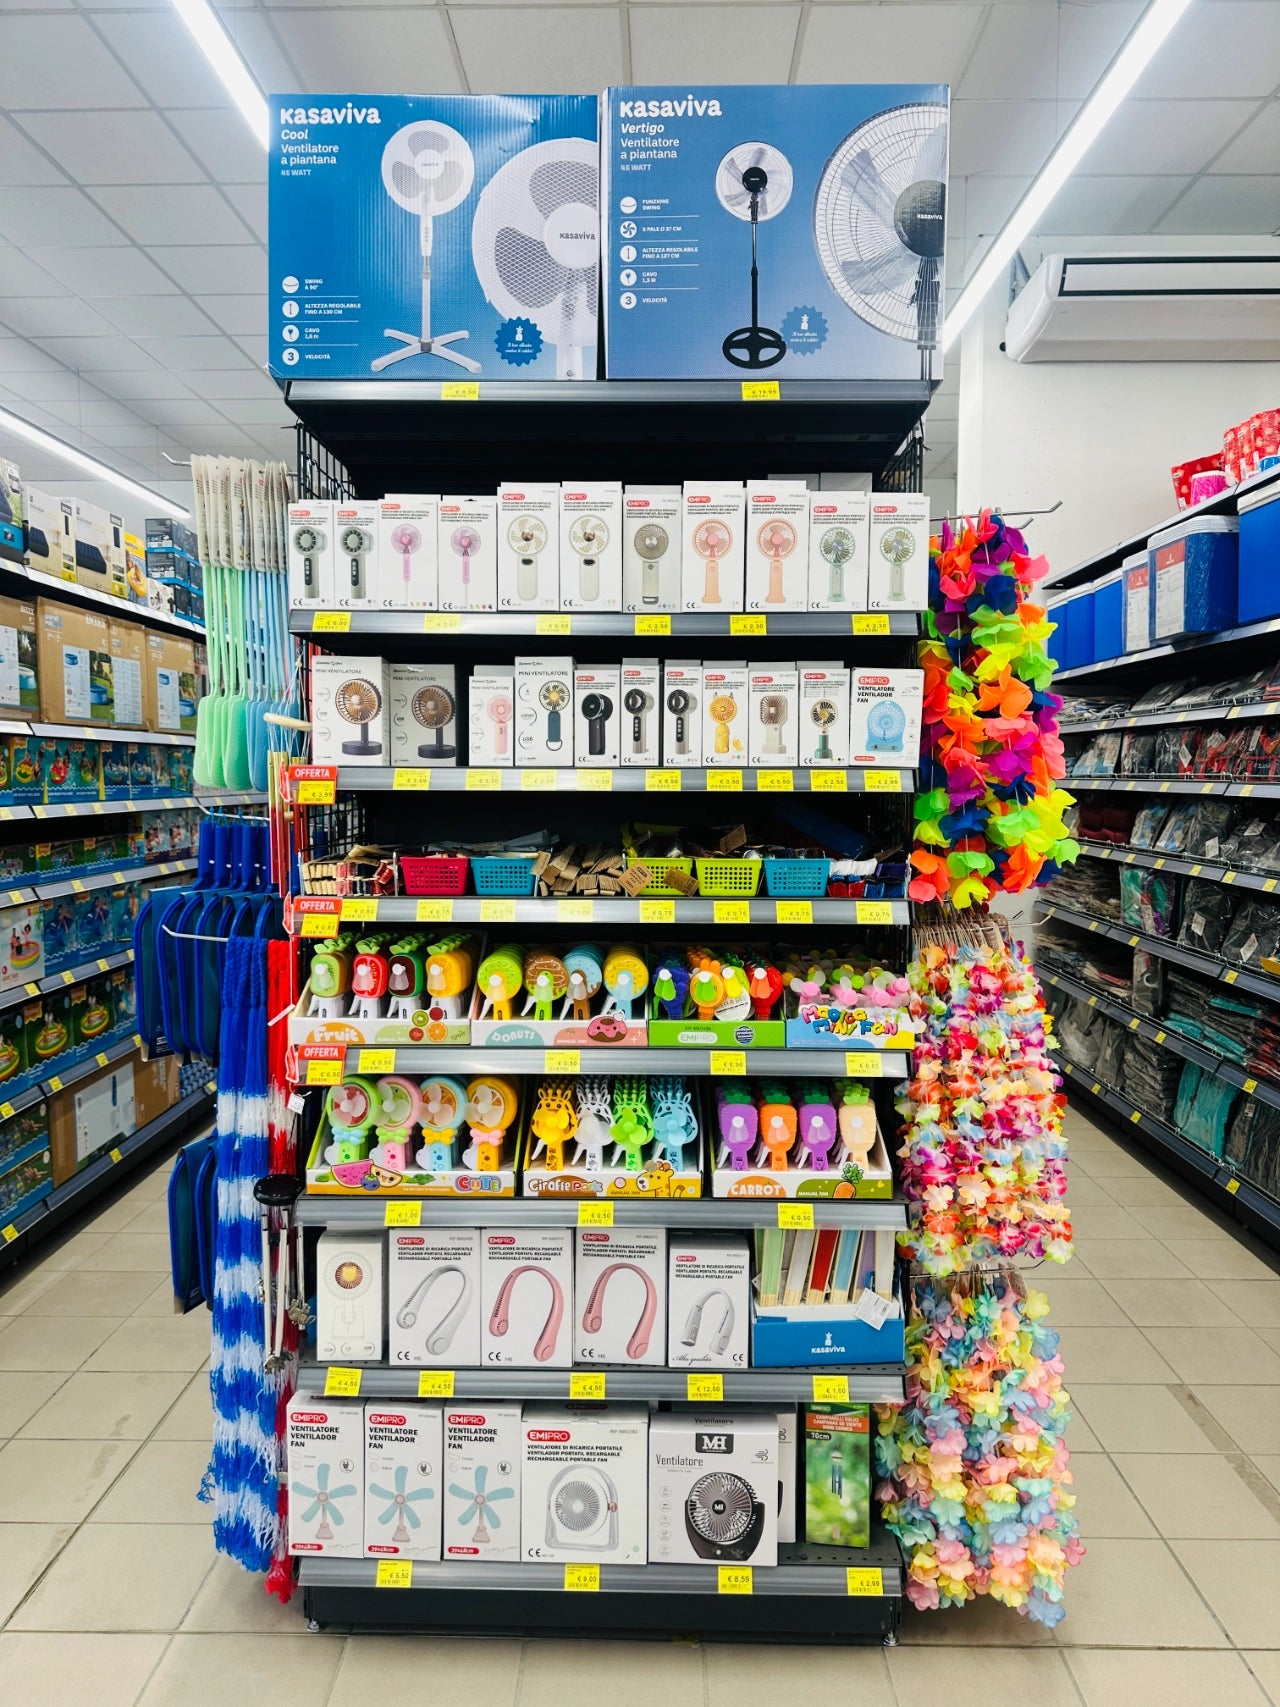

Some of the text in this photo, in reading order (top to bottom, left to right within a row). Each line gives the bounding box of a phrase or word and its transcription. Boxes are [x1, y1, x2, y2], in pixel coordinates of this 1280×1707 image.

[619, 94, 723, 118] Kasaviva
[280, 102, 382, 125] Kasaviva
[621, 122, 665, 136] Vertigo
[281, 129, 309, 140] Cool
[620, 137, 680, 148] Ventilatore
[281, 143, 340, 153] Ventilatore
[281, 154, 337, 167] a piantana
[620, 149, 678, 162] a piantana
[625, 295, 632, 305] 3
[287, 352, 295, 361] 3
[294, 768, 330, 778] OFFERTA
[300, 901, 335, 911] OFFERTA
[314, 1025, 359, 1043] Fruit
[304, 1047, 339, 1057] OFFERTA
[528, 1178, 571, 1192] Giraffe
[731, 1184, 780, 1196] CARROT
[292, 1413, 326, 1423] EMIPRO
[371, 1415, 405, 1425] EMIPRO
[450, 1415, 484, 1425] EMIPRO
[290, 1425, 340, 1433] VENTILATORE
[369, 1427, 419, 1436] VENTILATORE
[448, 1427, 498, 1435] VENTILATORE
[290, 1433, 337, 1441] VENTILADOR
[369, 1434, 416, 1443] VENTILADOR
[448, 1435, 495, 1443] VENTILADOR
[529, 1431, 568, 1441] EMIPRO
[290, 1440, 305, 1448] FAN
[368, 1442, 384, 1450] FAN
[448, 1442, 463, 1450] FAN
[655, 1454, 704, 1467] Ventilatore
[583, 1575, 597, 1583] 9,00
[865, 1580, 880, 1588] 2,99
